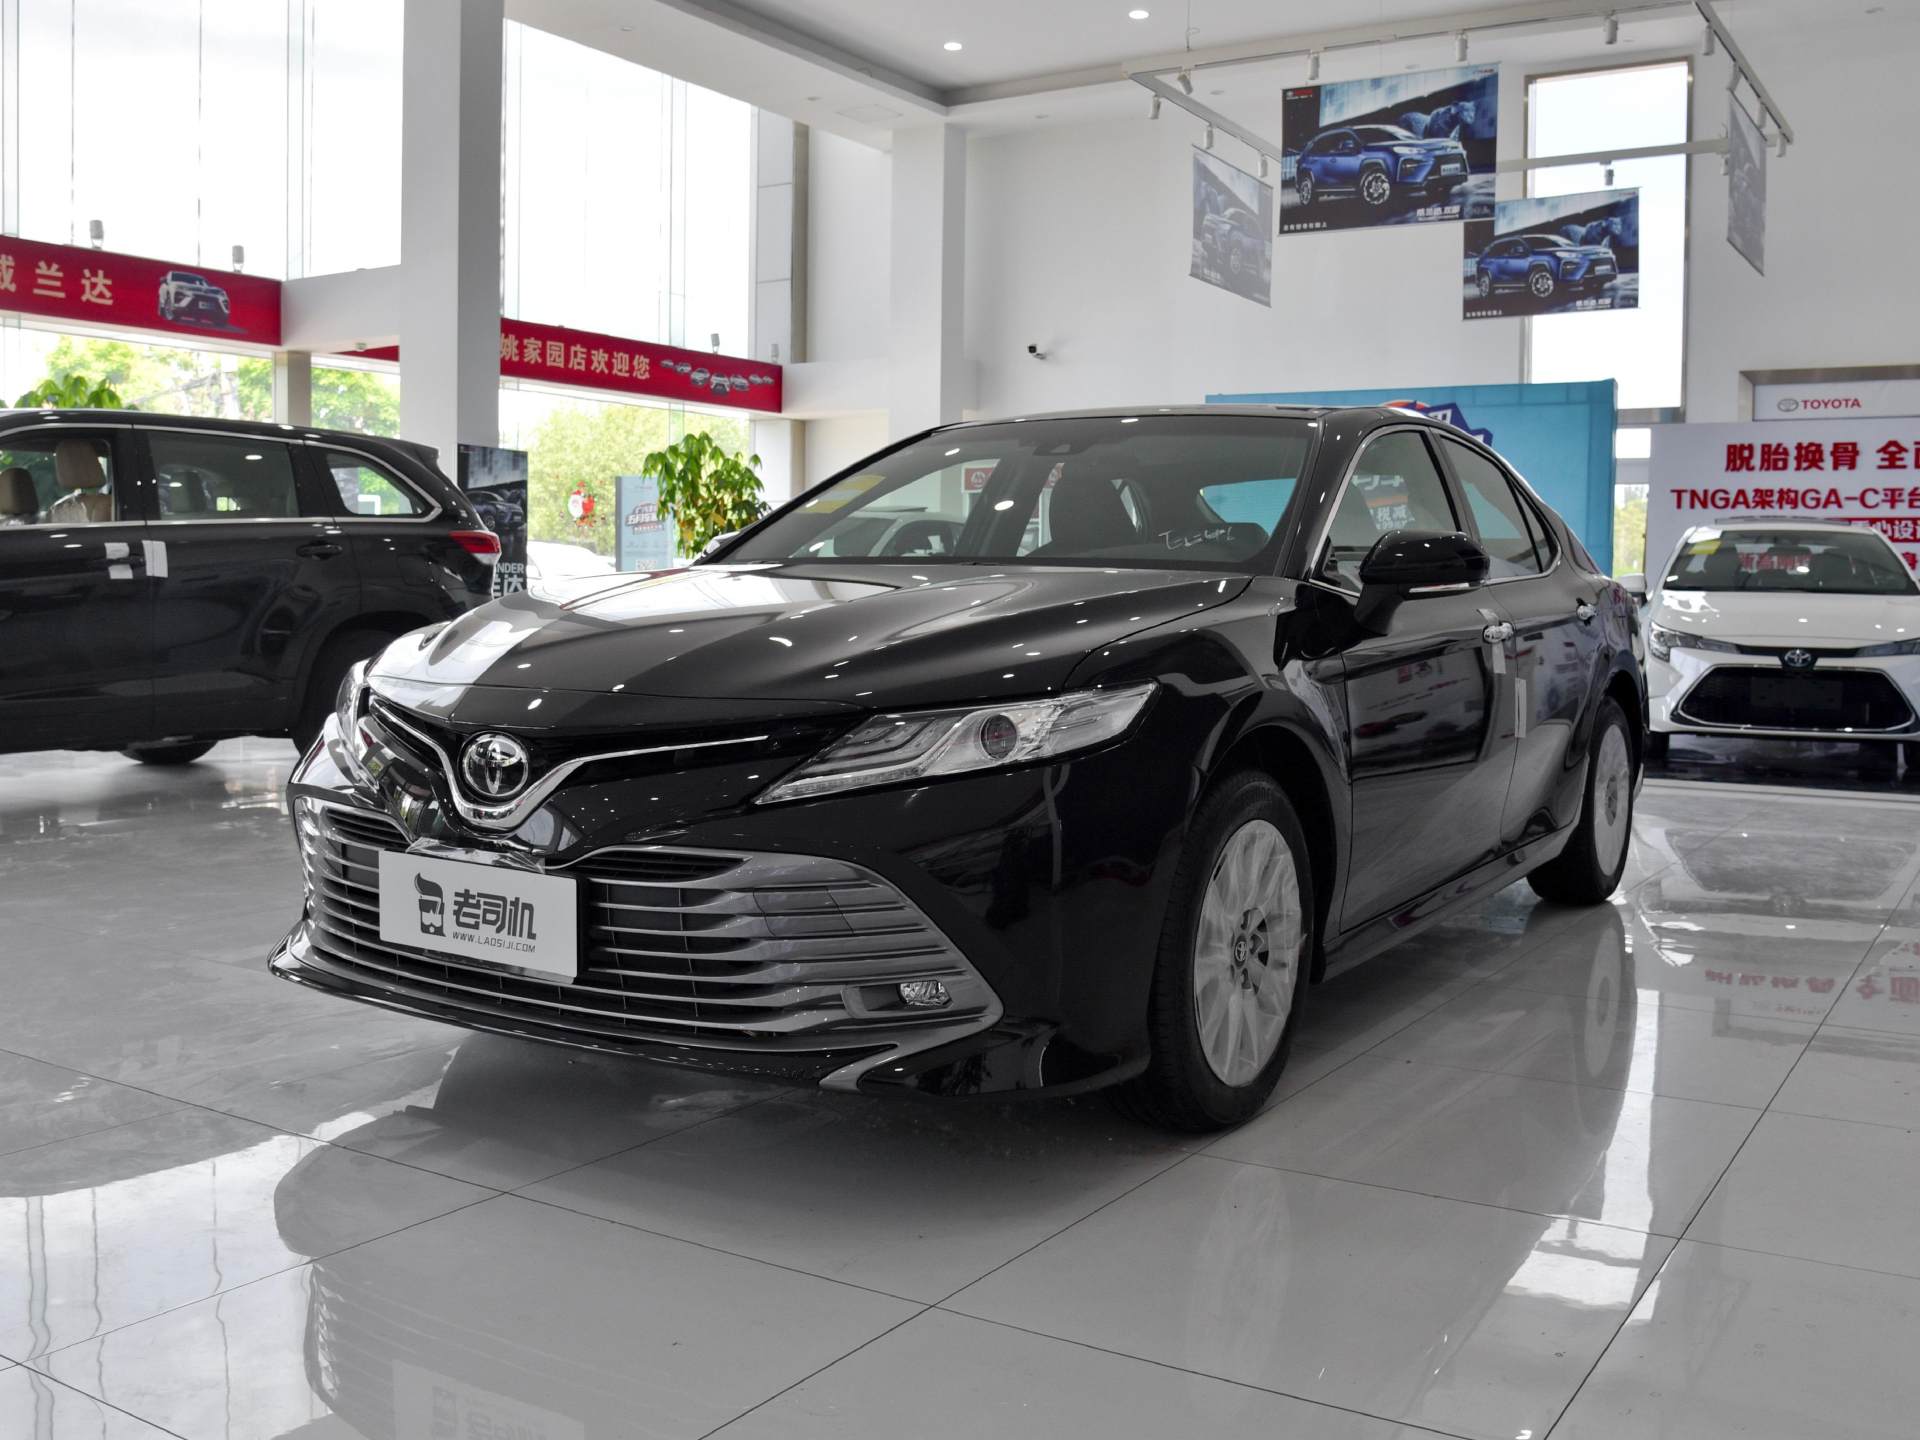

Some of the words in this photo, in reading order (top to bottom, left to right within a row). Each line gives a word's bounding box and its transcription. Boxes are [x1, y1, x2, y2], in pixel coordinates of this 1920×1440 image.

[500, 333, 650, 380] 姚家园店欢迎您
[1801, 398, 1861, 410] TOYOTA
[1725, 442, 1859, 472] 脱胎换骨
[1876, 440, 1920, 470] 全
[1670, 488, 1920, 510] TNGA架构GA-C平台
[453, 889, 536, 940] 老司机
[452, 931, 536, 953] WWW.LAOSIJI.COM
